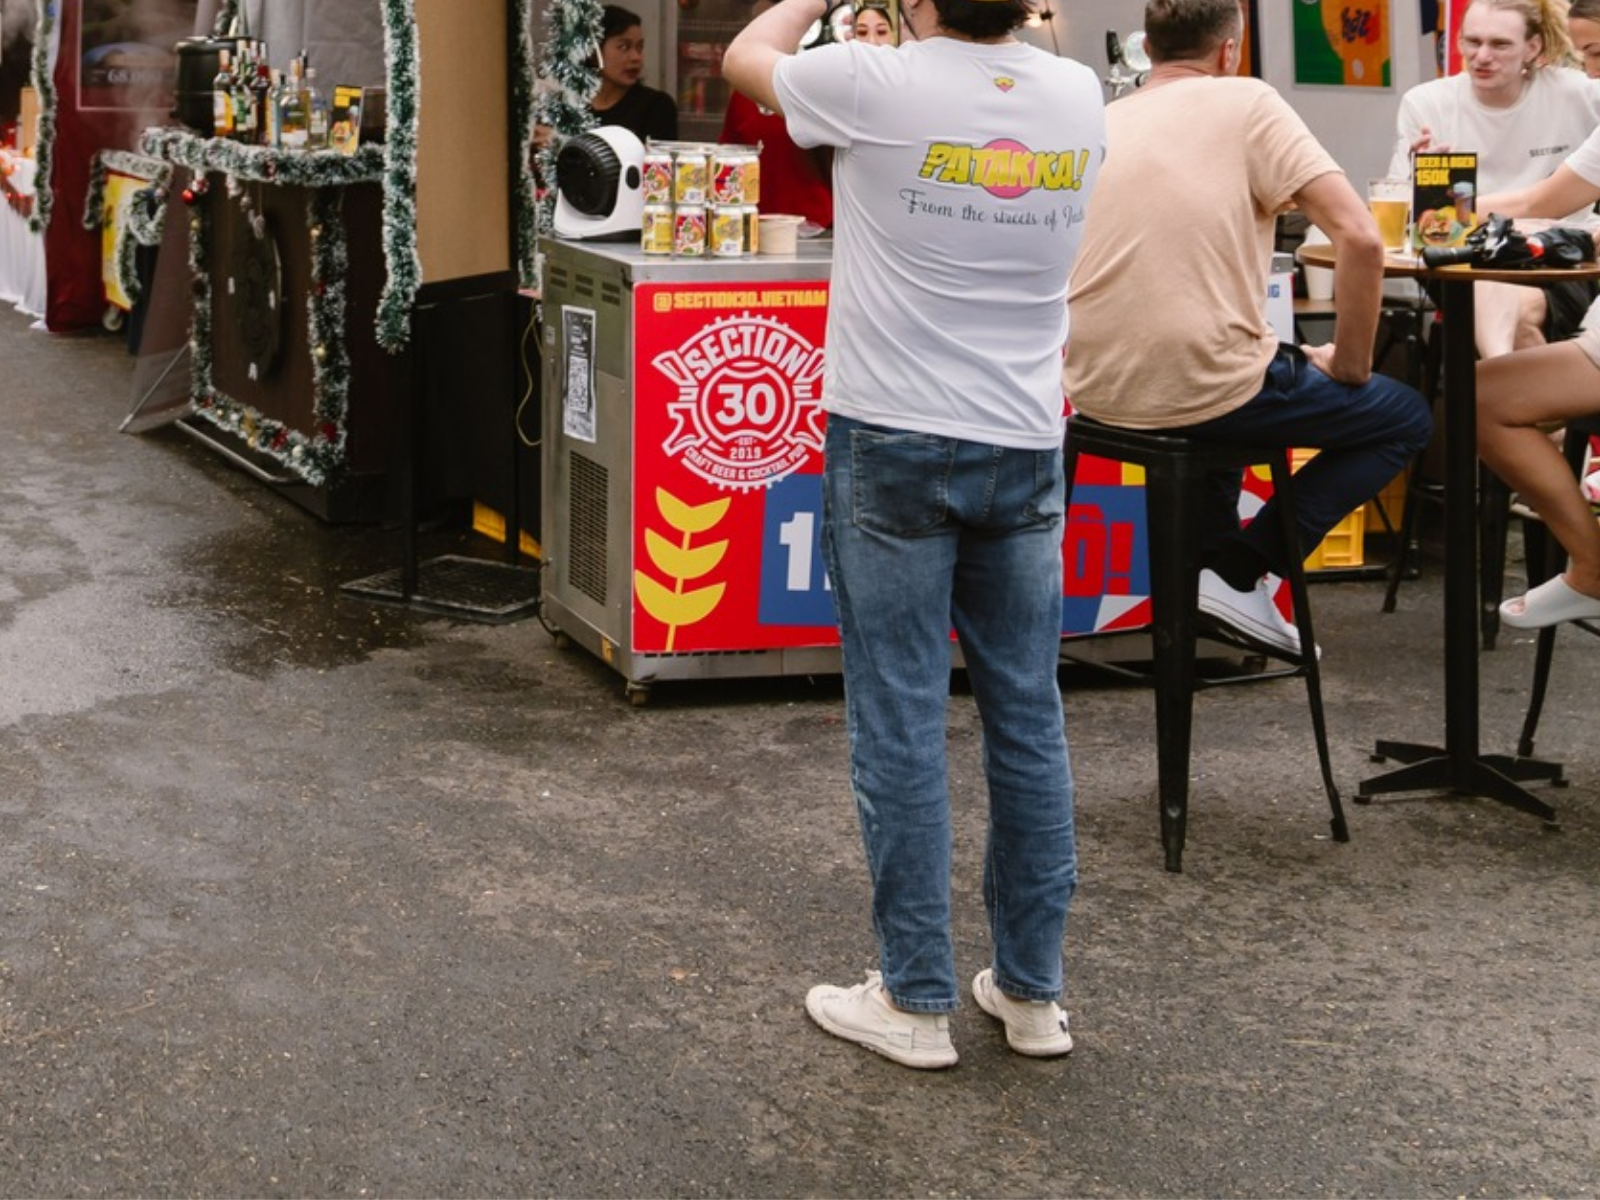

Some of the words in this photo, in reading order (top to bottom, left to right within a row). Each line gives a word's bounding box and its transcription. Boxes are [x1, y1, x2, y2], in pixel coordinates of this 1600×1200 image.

[918, 141, 1090, 192] PATAKKA!
[899, 188, 954, 215] From
[962, 204, 986, 224] the
[993, 208, 1038, 226] streets
[1043, 209, 1058, 233] of
[683, 324, 809, 381] SECTION
[714, 382, 777, 426] 30
[684, 446, 712, 472] CRAFT
[710, 464, 737, 480] BEER
[747, 457, 792, 480] COCKTAIL
